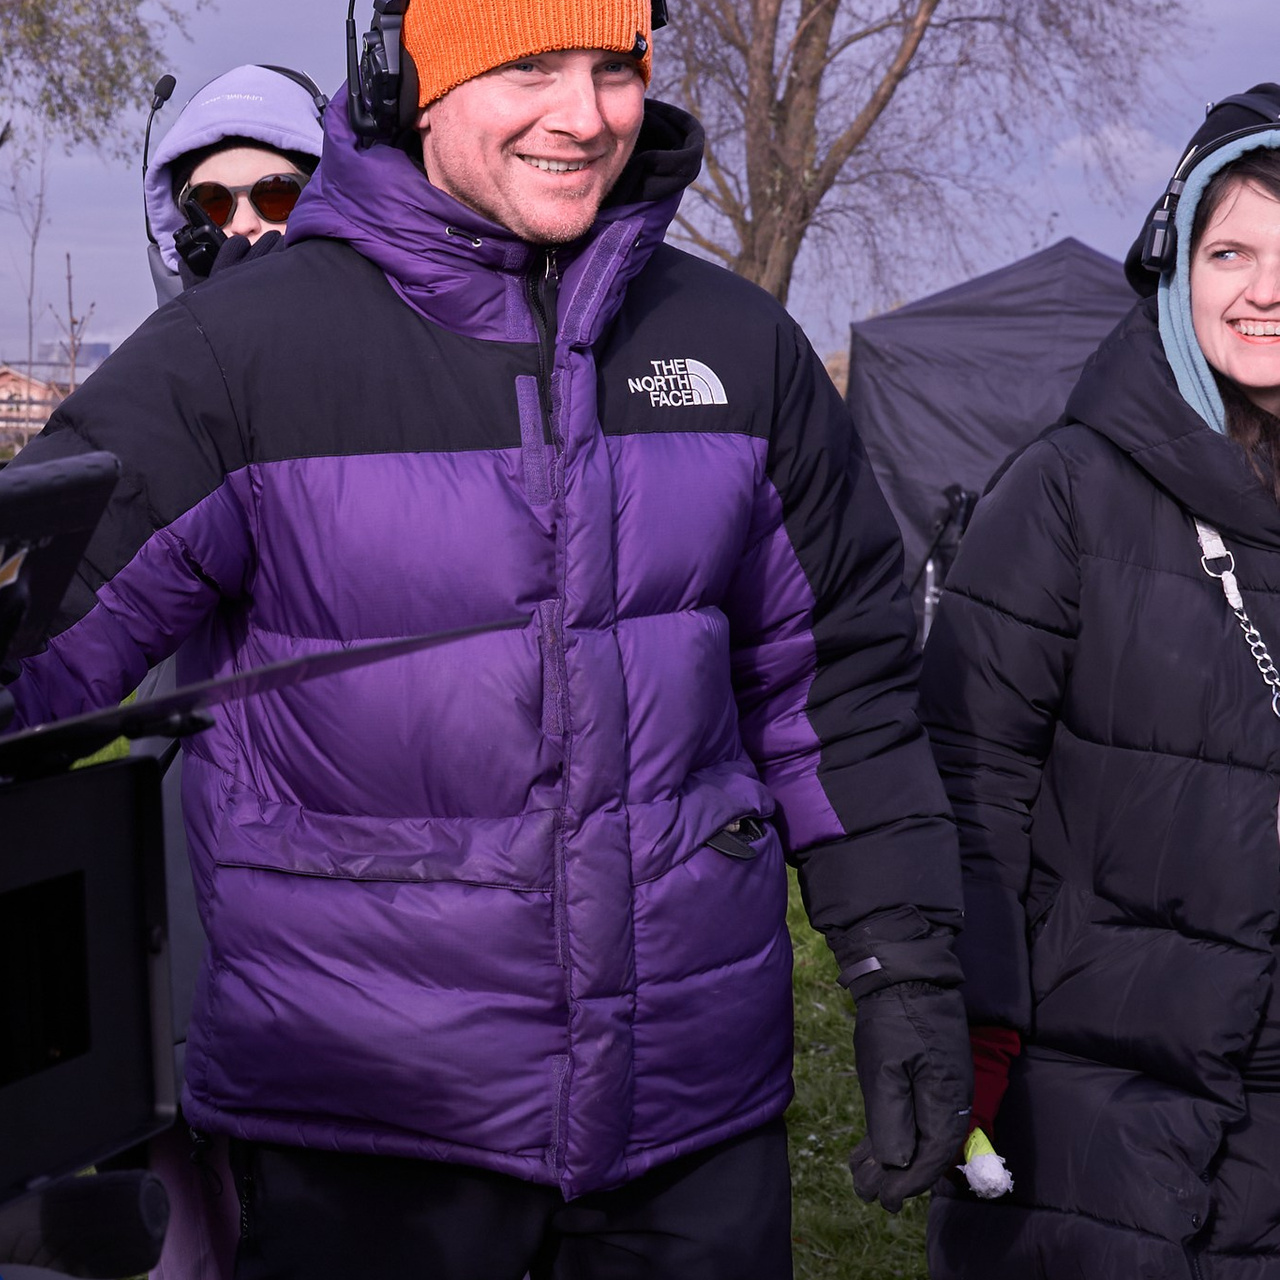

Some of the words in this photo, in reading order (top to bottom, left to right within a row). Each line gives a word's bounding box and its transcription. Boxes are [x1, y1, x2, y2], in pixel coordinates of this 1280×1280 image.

[650, 359, 687, 375] THE
[628, 374, 690, 393] NORTH
[650, 390, 695, 407] FACE
